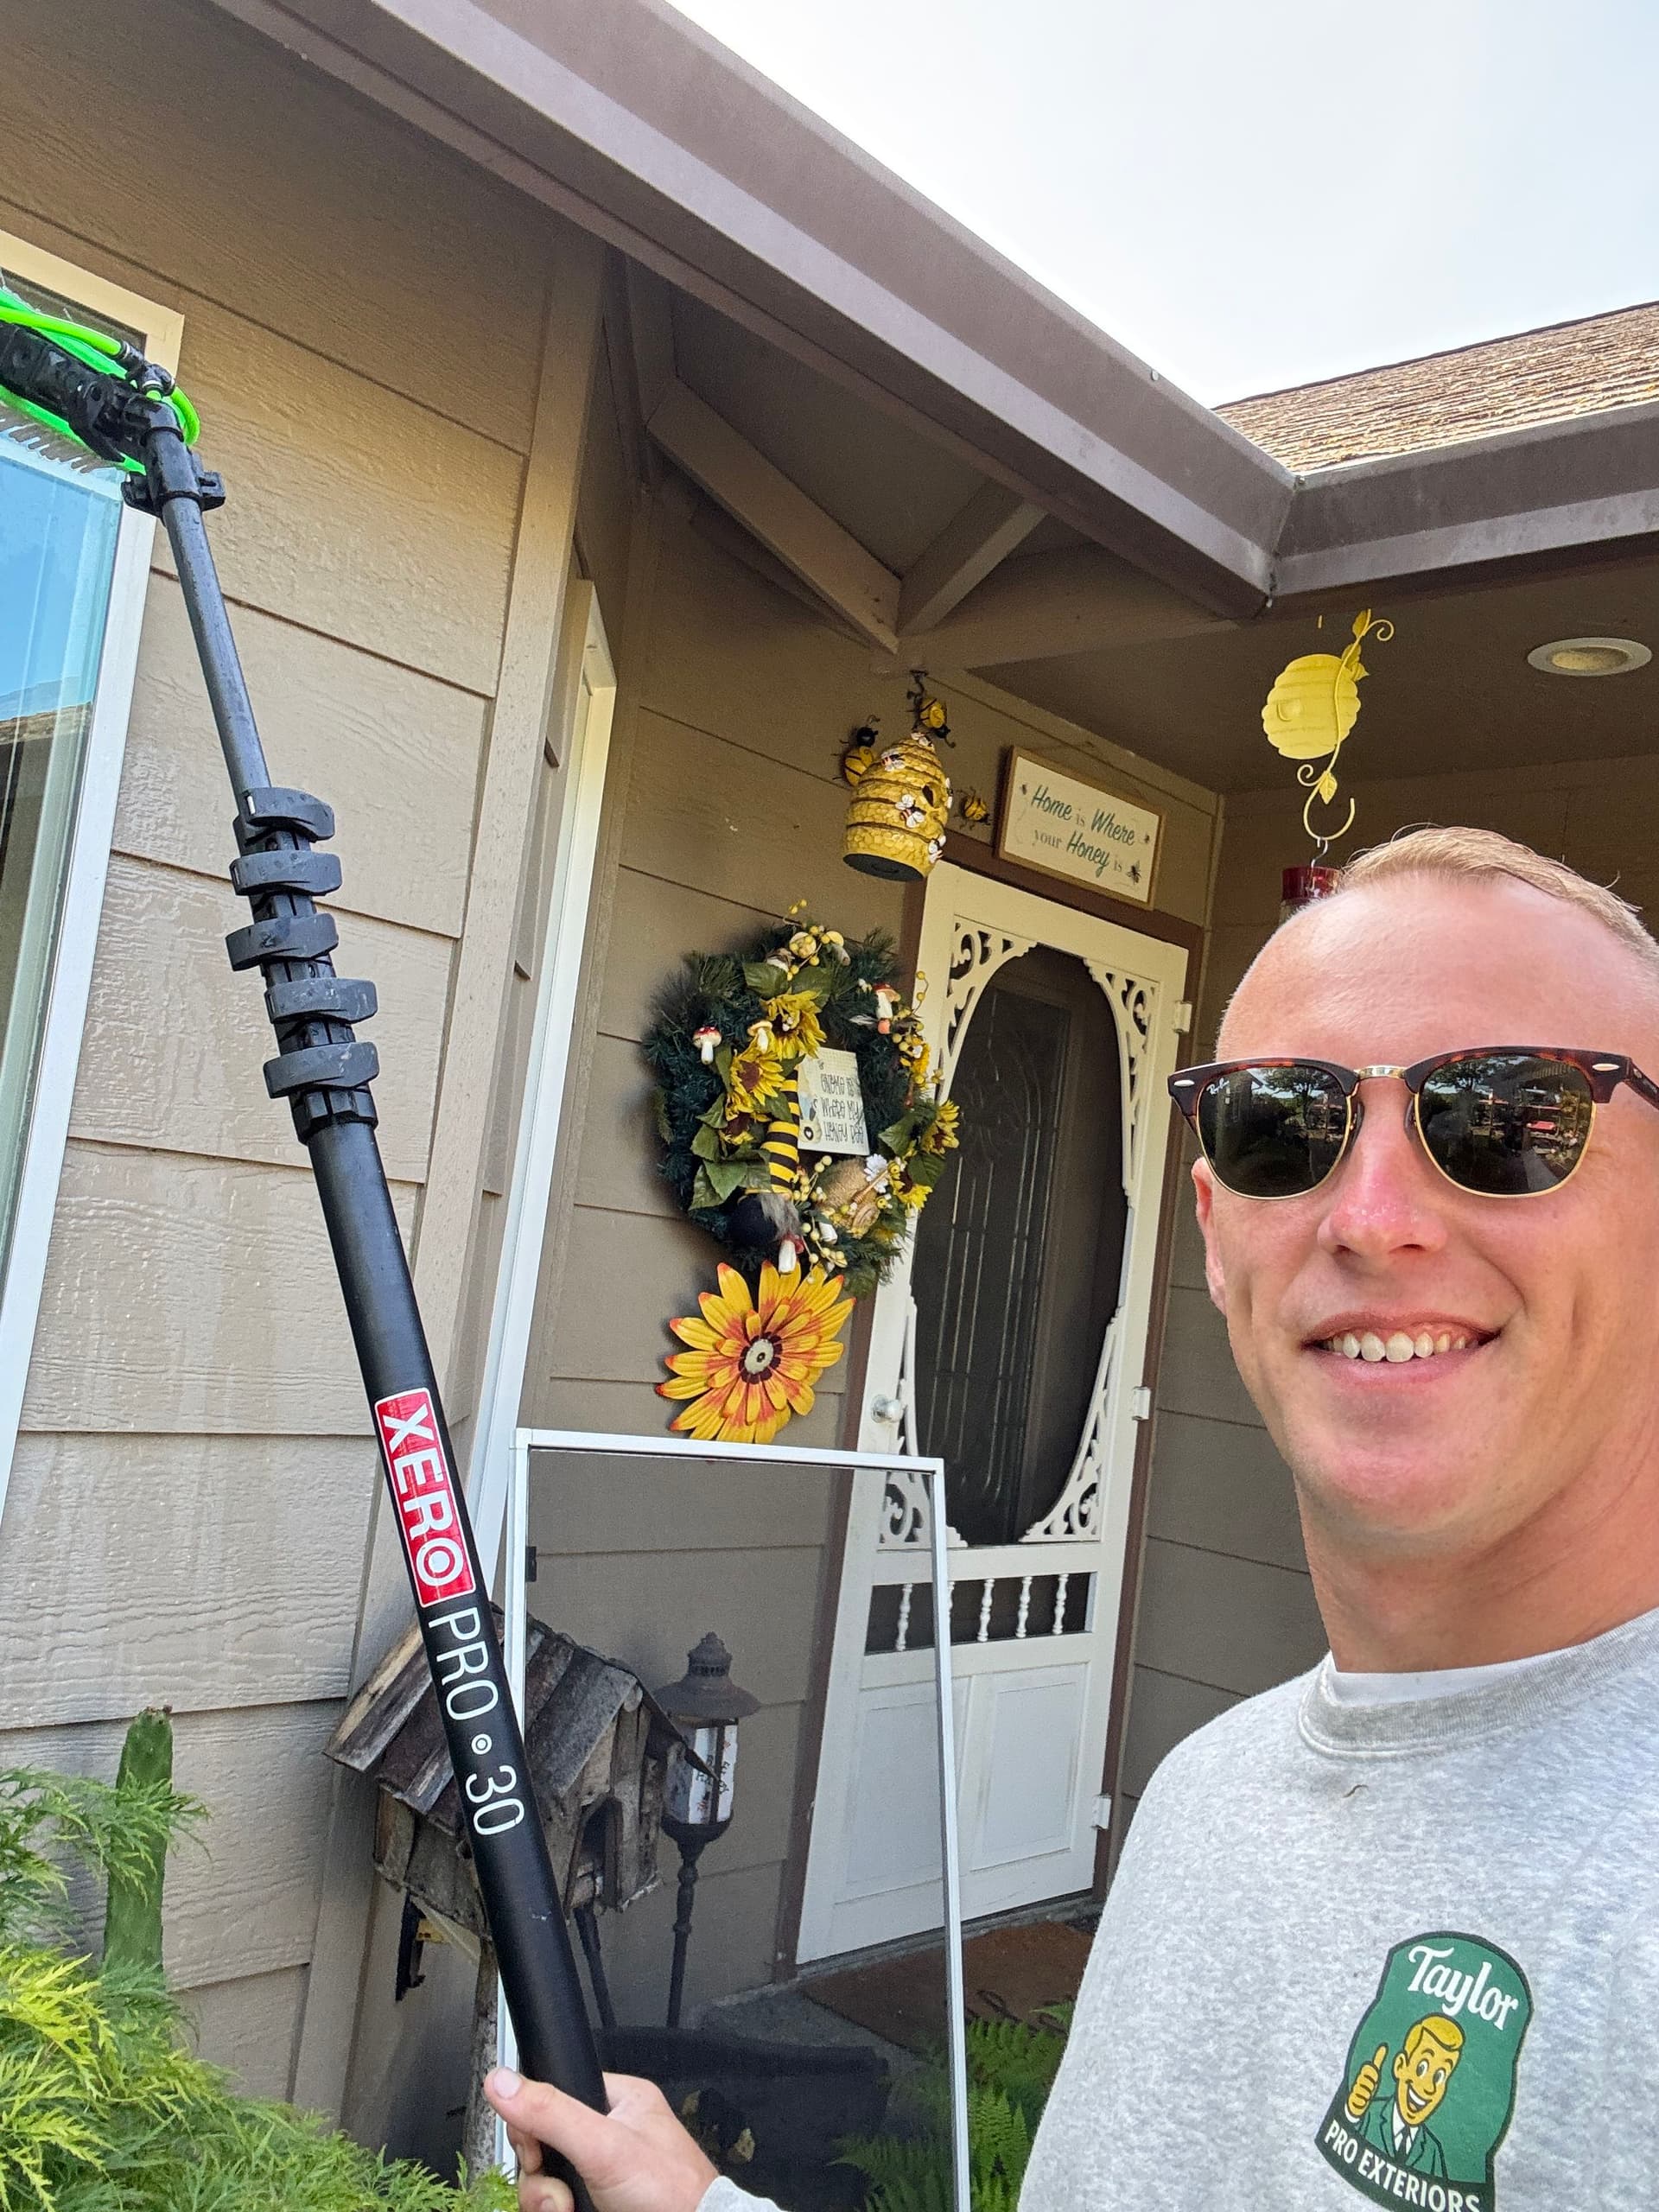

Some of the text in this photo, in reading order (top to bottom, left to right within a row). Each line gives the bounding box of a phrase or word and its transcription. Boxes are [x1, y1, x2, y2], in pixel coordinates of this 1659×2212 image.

[1031, 784, 1135, 846] Home is Where
[1032, 830, 1122, 878] your Honey is
[382, 1402, 464, 1587] XERO
[429, 1607, 525, 1837] PRO 30
[1408, 1945, 1519, 2031] Taylor
[1324, 2120, 1480, 2212] PRO EXTERIORS
